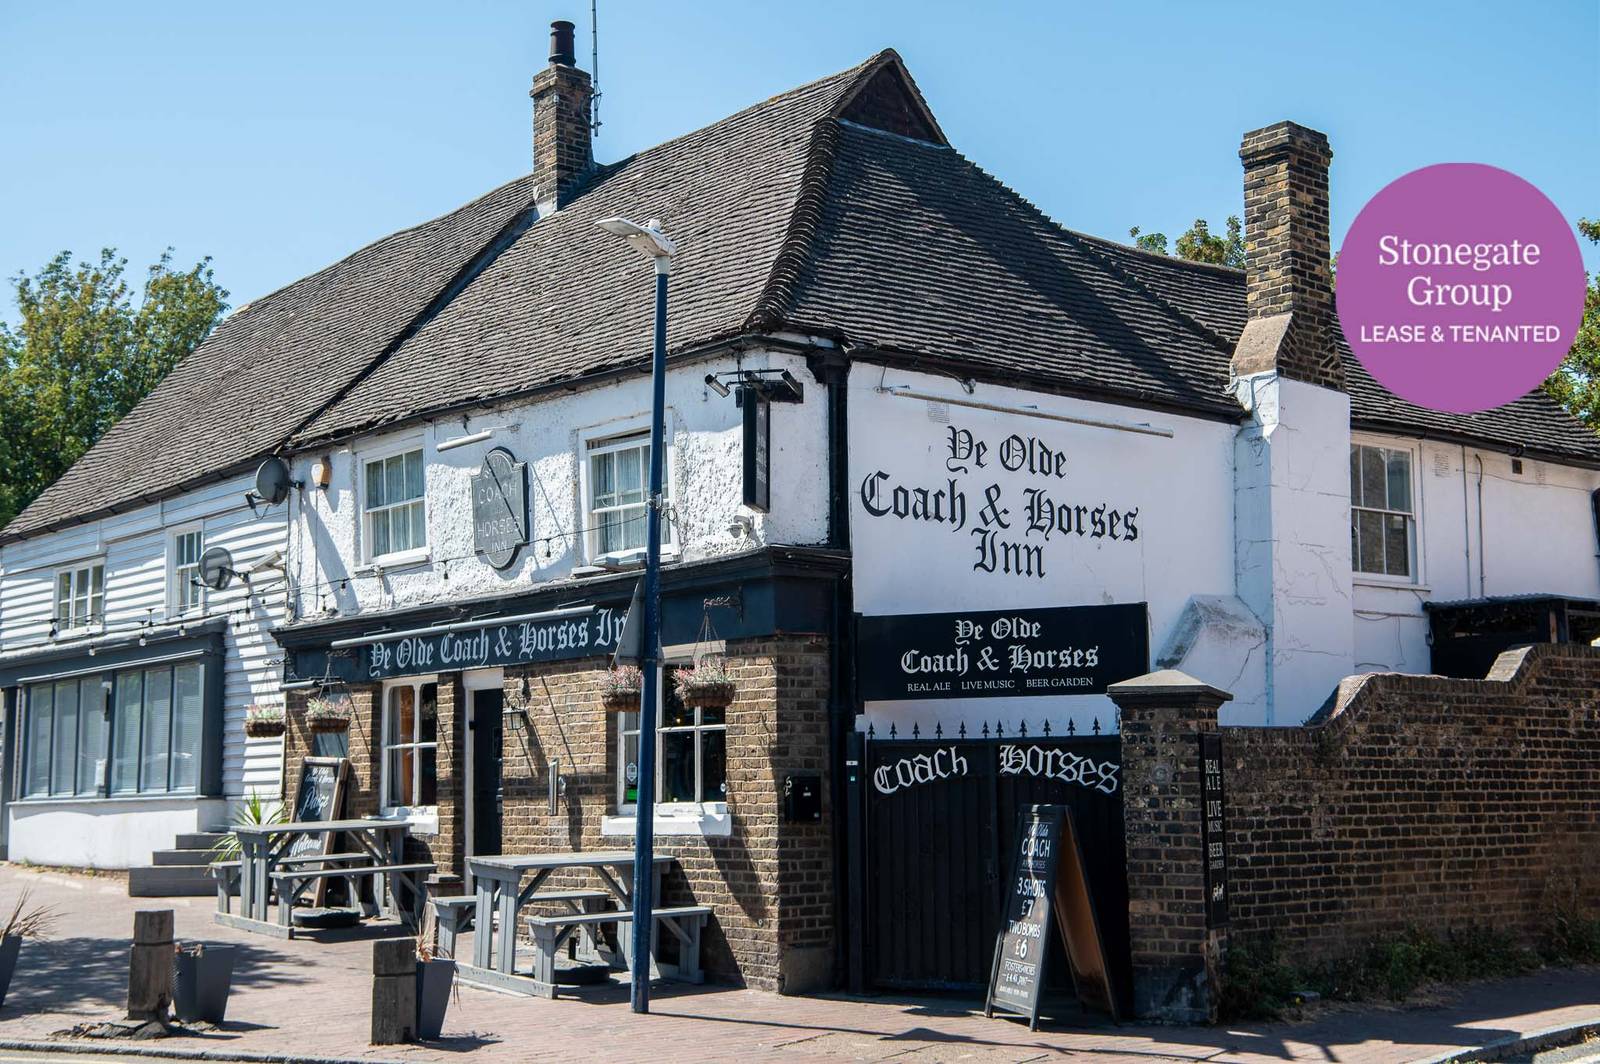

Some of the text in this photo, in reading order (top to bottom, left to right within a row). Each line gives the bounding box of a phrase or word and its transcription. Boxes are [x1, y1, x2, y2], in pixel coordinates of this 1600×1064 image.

[946, 425, 1068, 479] Ye Olde
[479, 482, 517, 505] COACH
[861, 470, 1140, 542] Coach & Horses
[477, 516, 521, 539] HORSES
[491, 541, 508, 553] INN
[971, 527, 1046, 579] Inn
[954, 616, 1042, 645] Ye Olde
[369, 642, 391, 678] Ye
[396, 637, 434, 668] Olde
[440, 627, 490, 666] Coach
[494, 626, 512, 658] &
[518, 617, 589, 660] Horses
[900, 644, 1099, 677] Coach & Horses
[907, 677, 1094, 692] REAL ALE LIVE MUSIC BEER GARDEN
[873, 744, 1120, 795] Coach Horses
[1205, 759, 1221, 774] REAL
[1206, 775, 1221, 791] ALE
[1207, 800, 1222, 818] LIVE
[1208, 820, 1223, 833] MUSIC
[1021, 838, 1051, 858] COACH
[1209, 842, 1224, 858] BEER
[1017, 877, 1046, 898] 3 SHOTS
[1021, 899, 1035, 917] £7
[1009, 920, 1041, 938] TWO BOMBS
[1015, 939, 1028, 959] £6
